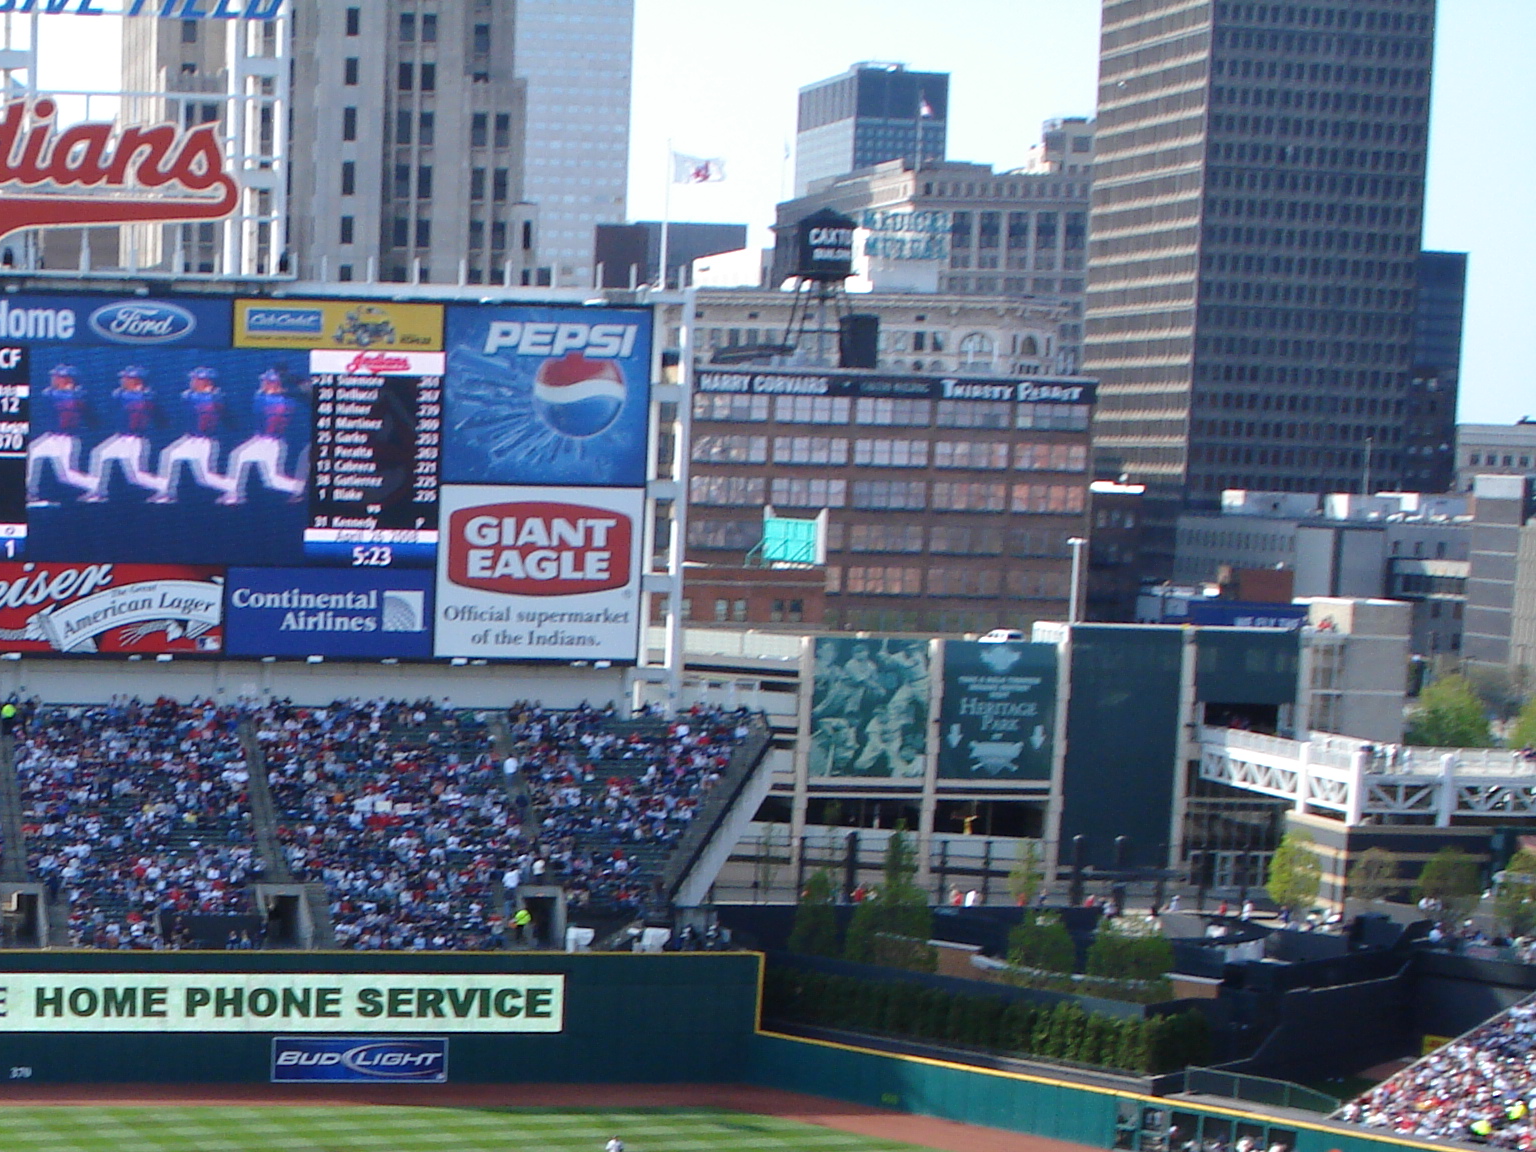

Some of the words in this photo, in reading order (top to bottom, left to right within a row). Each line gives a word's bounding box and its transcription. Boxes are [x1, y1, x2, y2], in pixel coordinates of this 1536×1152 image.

[110, 310, 173, 337] Ford
[483, 321, 639, 357] PEPSI
[0, 397, 21, 413] 12
[465, 515, 616, 548] GIANT
[5, 540, 15, 558] 1
[352, 546, 392, 566] 5:23
[467, 549, 611, 580] EAGLE
[232, 588, 377, 609] Continental
[64, 596, 153, 638] American
[159, 592, 216, 615] Lager
[279, 610, 377, 632] Airlines
[443, 605, 510, 626] Official
[516, 607, 629, 630] supermarket
[471, 630, 493, 647] of
[496, 630, 524, 647] the
[528, 630, 601, 647] Indians.
[35, 986, 169, 1018] HOME
[185, 986, 344, 1018] PHONE
[355, 986, 554, 1019] SERVICE
[276, 1050, 344, 1067] BUD
[355, 1051, 443, 1068] LIGHT
